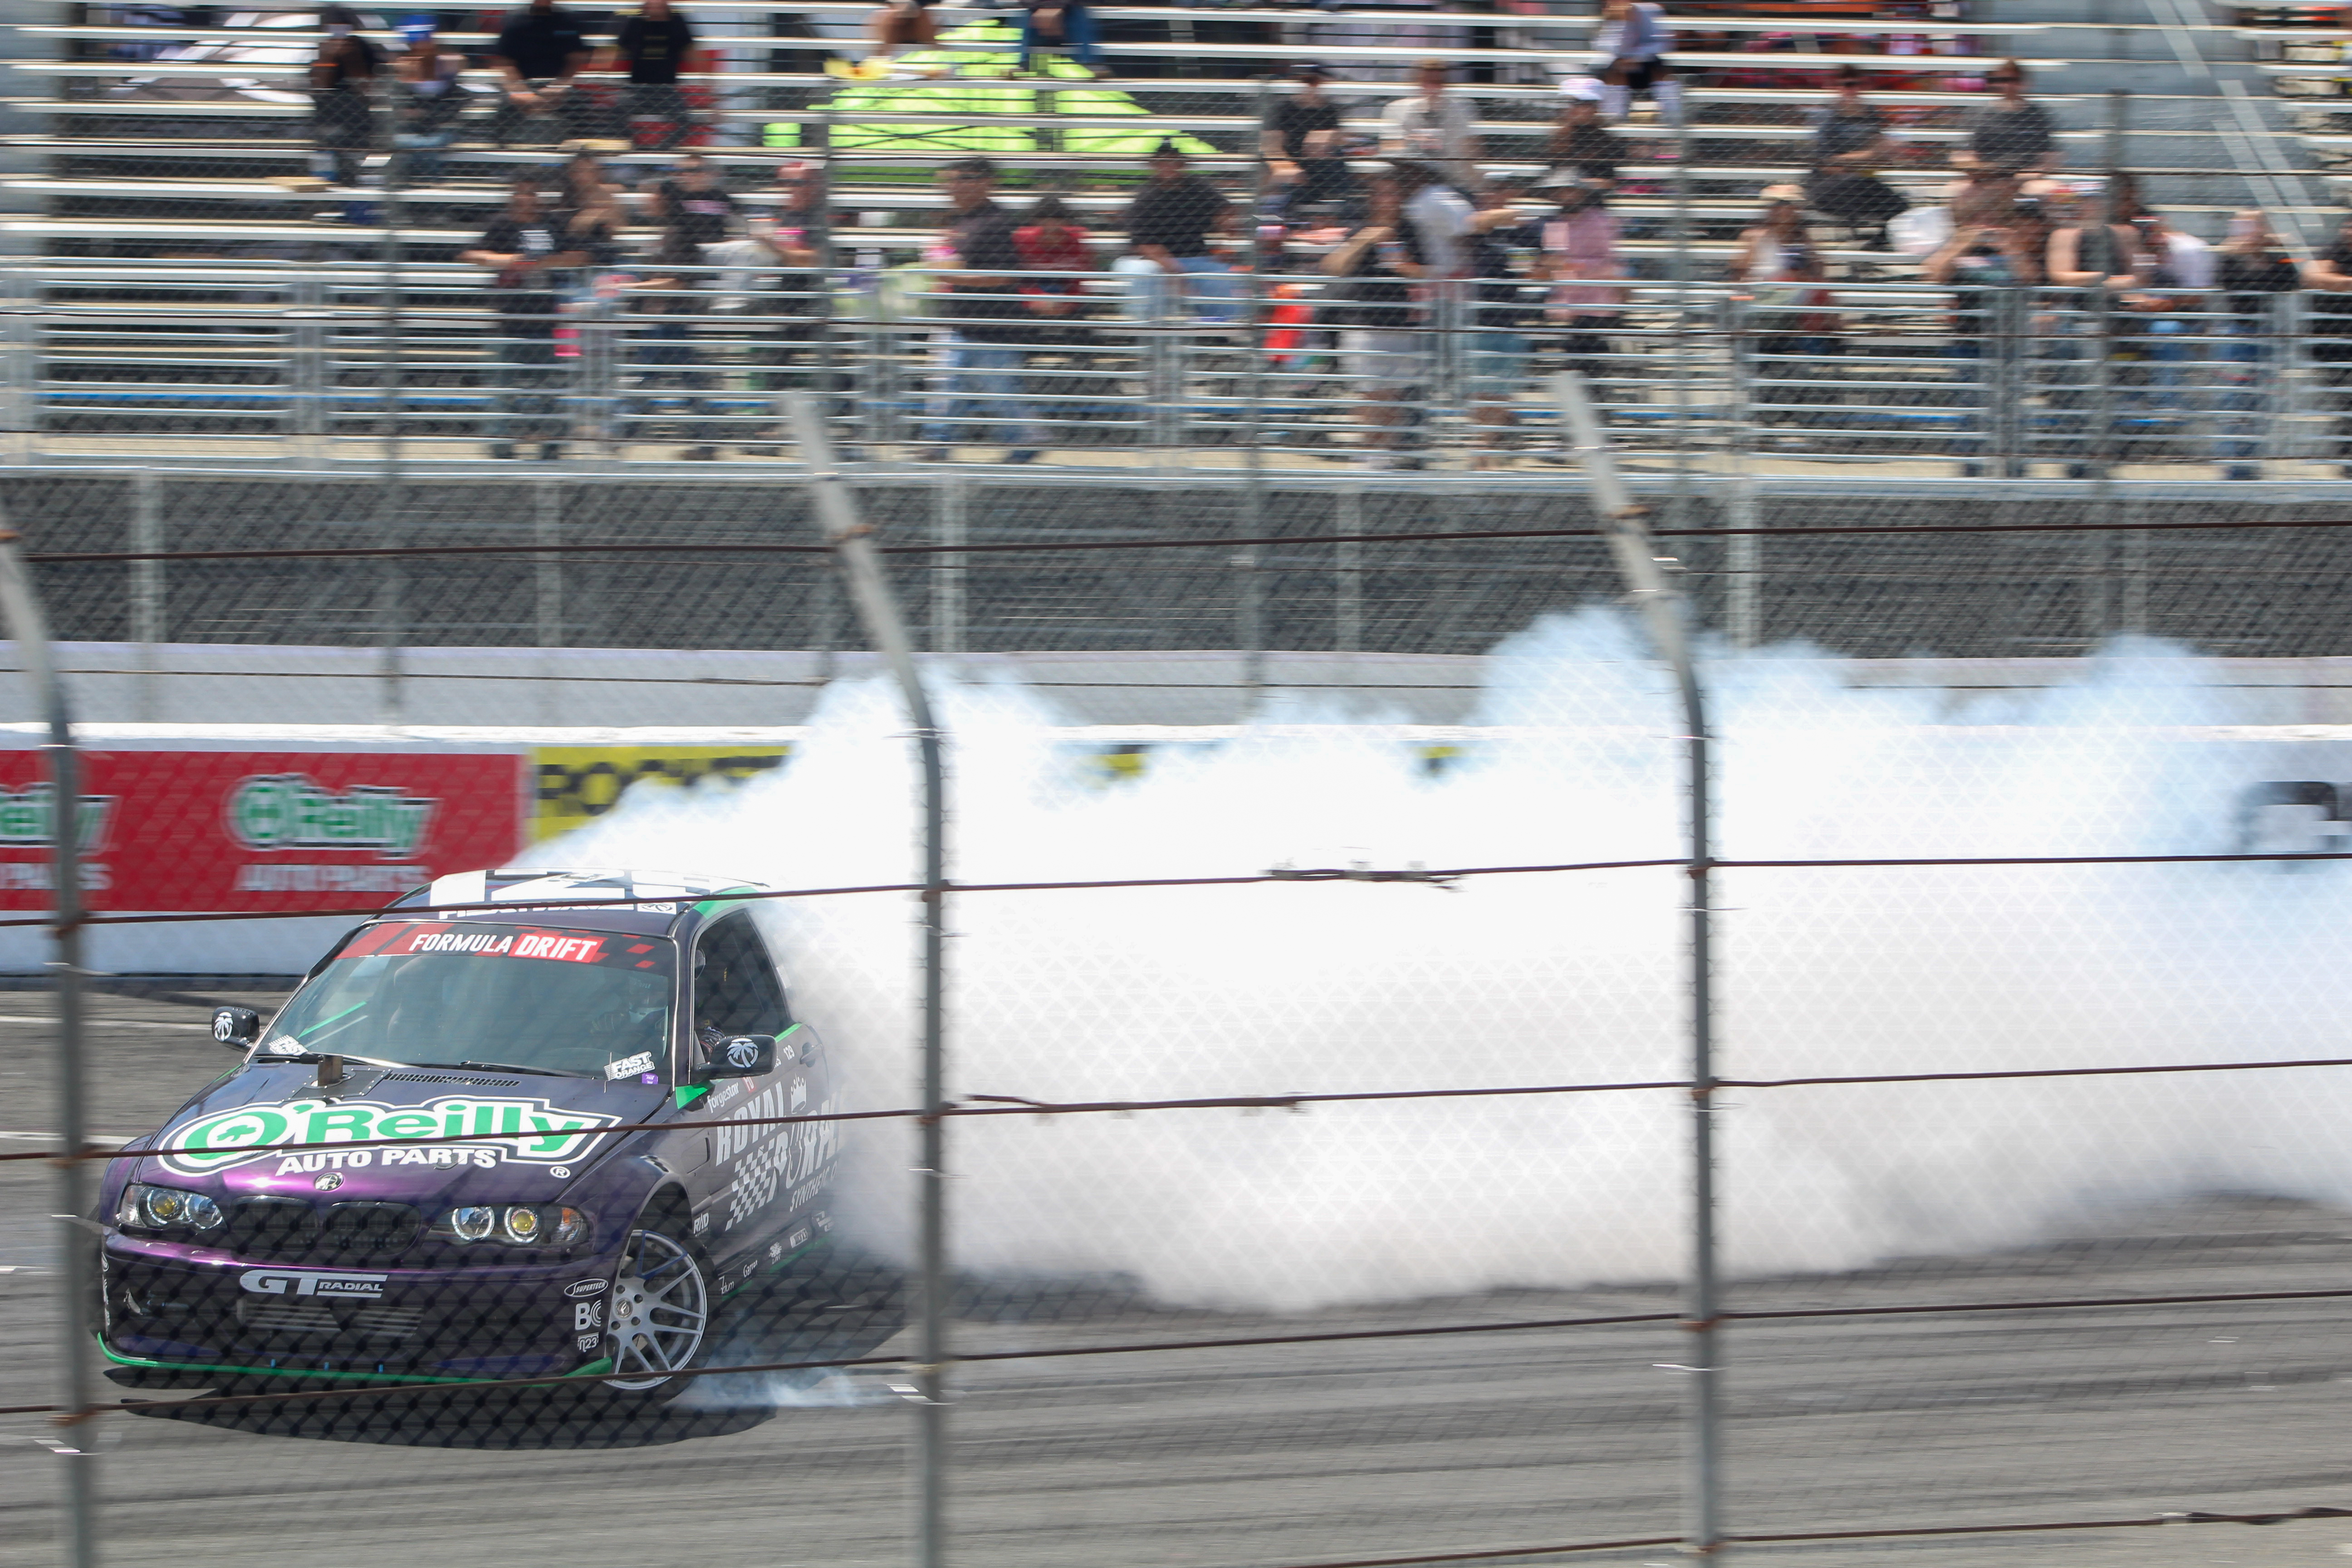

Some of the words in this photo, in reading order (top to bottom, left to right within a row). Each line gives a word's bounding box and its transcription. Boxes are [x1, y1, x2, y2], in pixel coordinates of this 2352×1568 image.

[409, 933, 513, 953] FORMULA
[514, 935, 598, 960] DRIFT
[611, 1051, 652, 1073] FAST
[783, 1044, 795, 1060] 129
[614, 1061, 654, 1079] ORANGE
[707, 1082, 740, 1113] forgestar
[183, 1102, 586, 1161] O'Reilly
[715, 1081, 787, 1167] ROYAL
[274, 1151, 373, 1176] AUTO
[381, 1148, 497, 1169] PARTS
[693, 1212, 709, 1234] RAD
[318, 1281, 384, 1292] RADIAL
[575, 1280, 606, 1294] SUPERTECH
